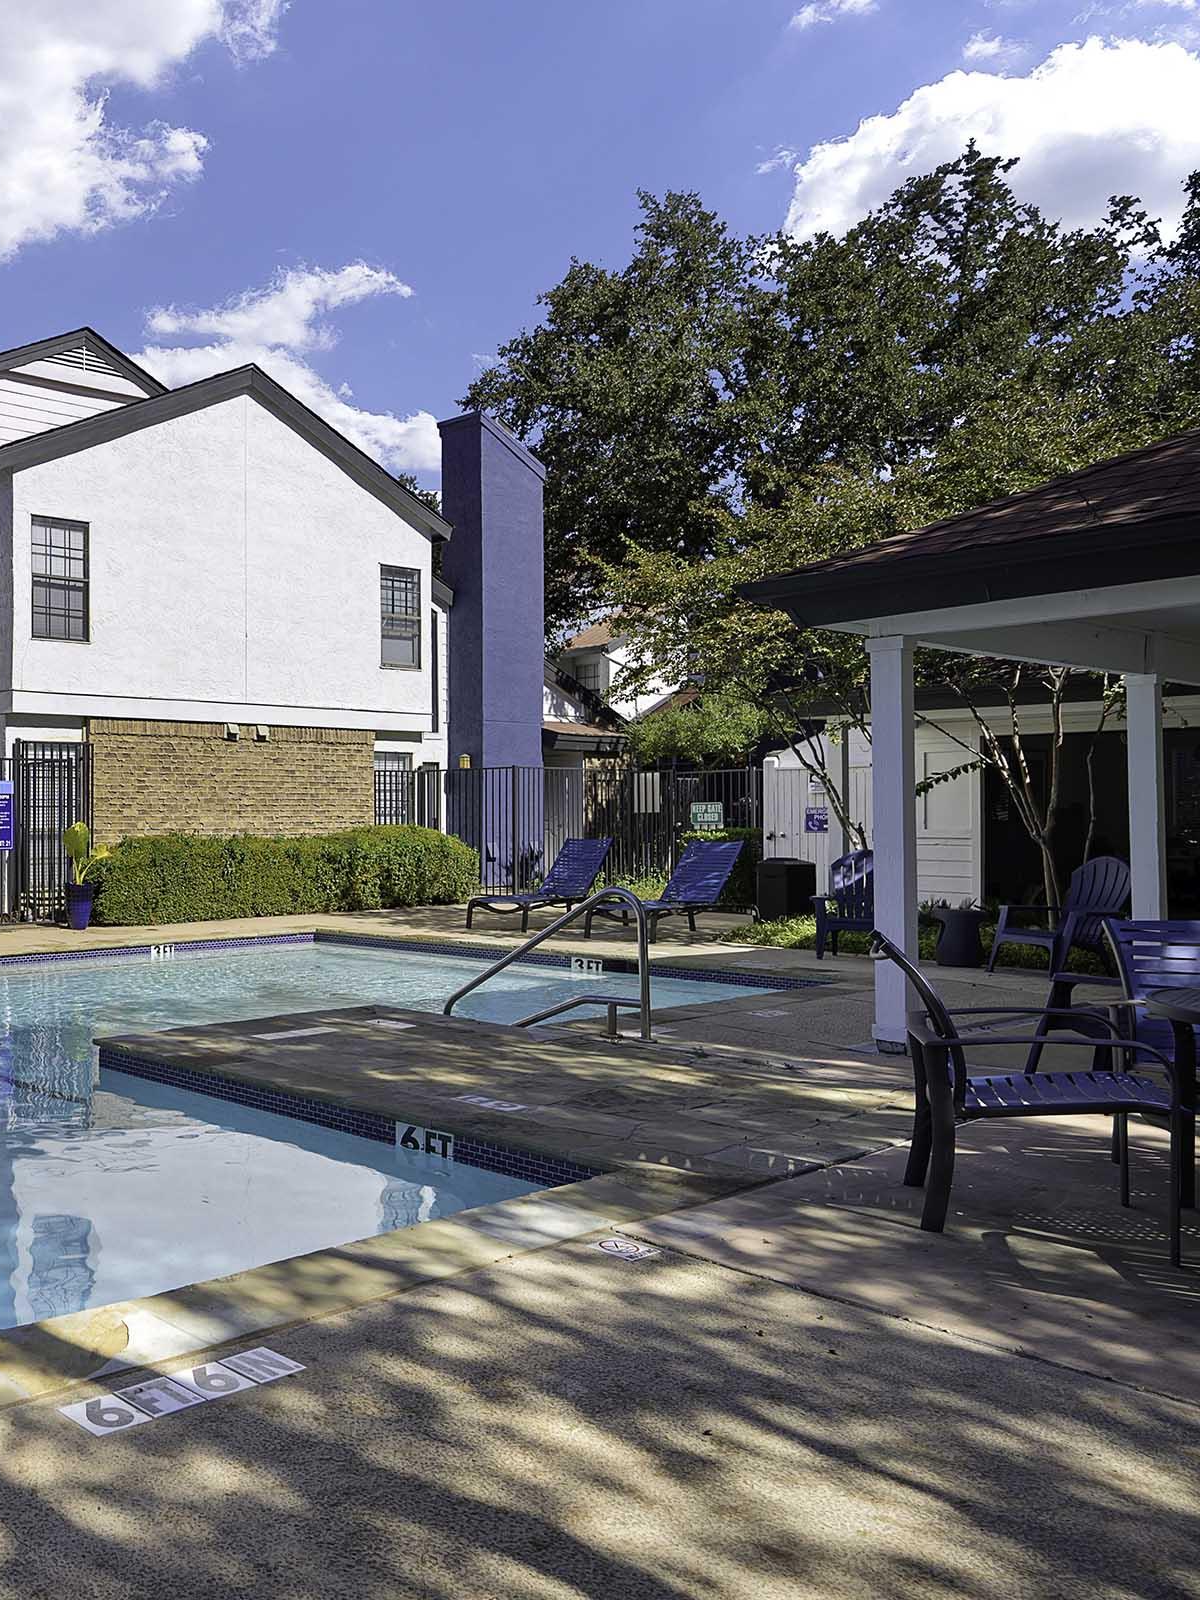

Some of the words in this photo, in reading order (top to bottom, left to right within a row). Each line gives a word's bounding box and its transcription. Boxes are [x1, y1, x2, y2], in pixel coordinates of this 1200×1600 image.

[400, 1126, 420, 1150] 6
[425, 1131, 452, 1158] FT
[85, 1400, 135, 1428] 6
[119, 1377, 196, 1415] FT
[191, 1366, 241, 1393] 6
[219, 1347, 302, 1383] IN
